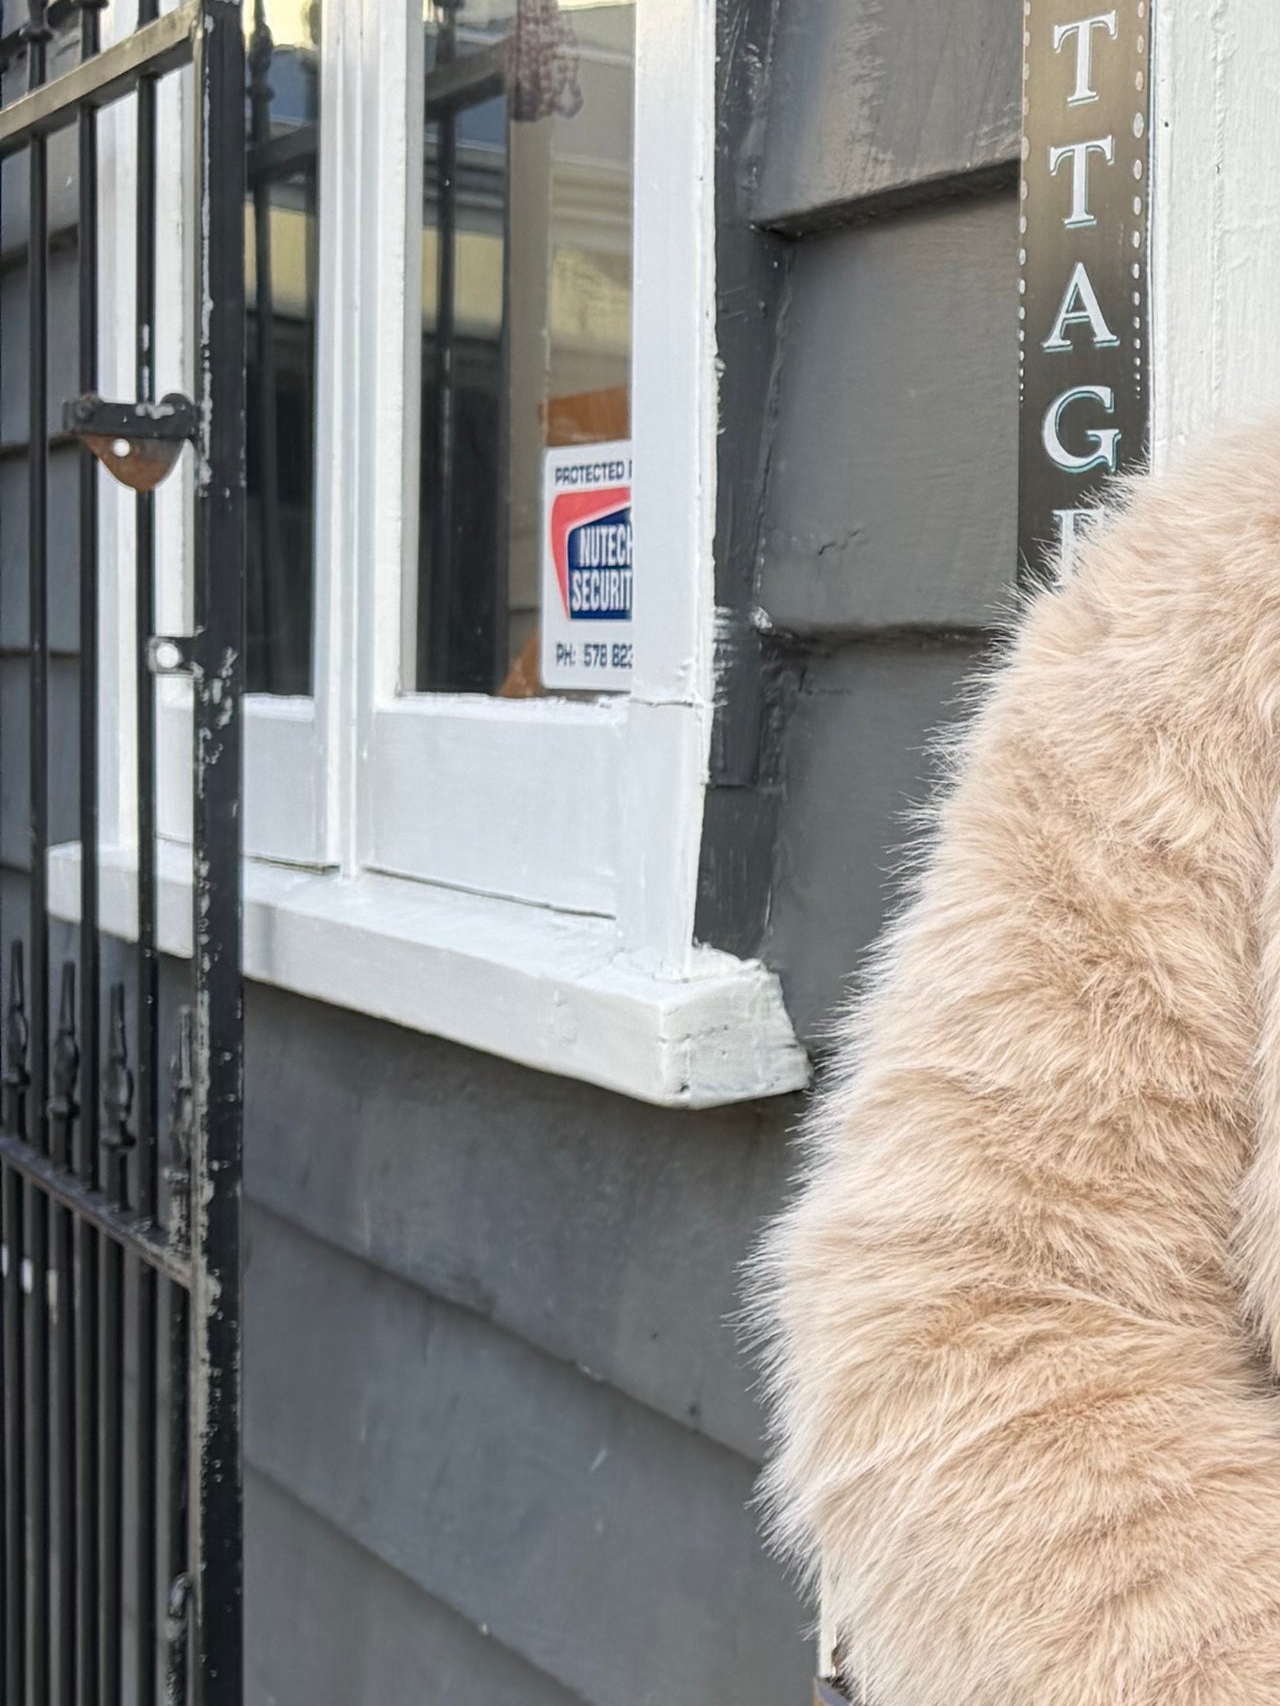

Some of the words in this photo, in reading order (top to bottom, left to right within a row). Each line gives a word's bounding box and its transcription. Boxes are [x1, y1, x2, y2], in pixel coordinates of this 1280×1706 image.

[555, 460, 625, 485] PROTECTED
[571, 569, 632, 611] SECURIT
[583, 643, 608, 668] 578
